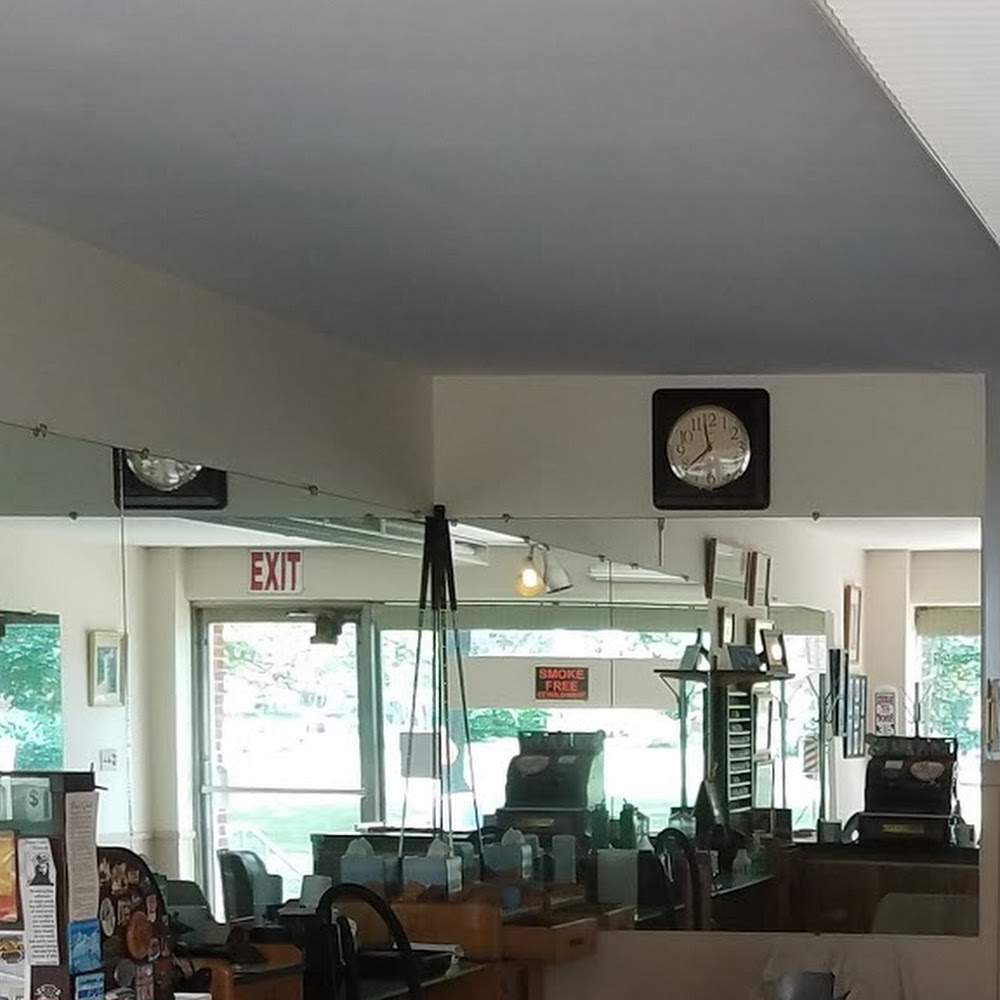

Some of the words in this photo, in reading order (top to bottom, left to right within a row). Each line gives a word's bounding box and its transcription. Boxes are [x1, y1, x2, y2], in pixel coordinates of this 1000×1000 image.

[691, 418, 701, 431] 11
[680, 429, 693, 444] 10
[730, 426, 739, 440] 2
[677, 445, 685, 456] 9
[706, 472, 716, 484] 6
[250, 551, 301, 591] EXIT
[539, 668, 584, 680] SMOKE
[545, 680, 577, 691] FREE
